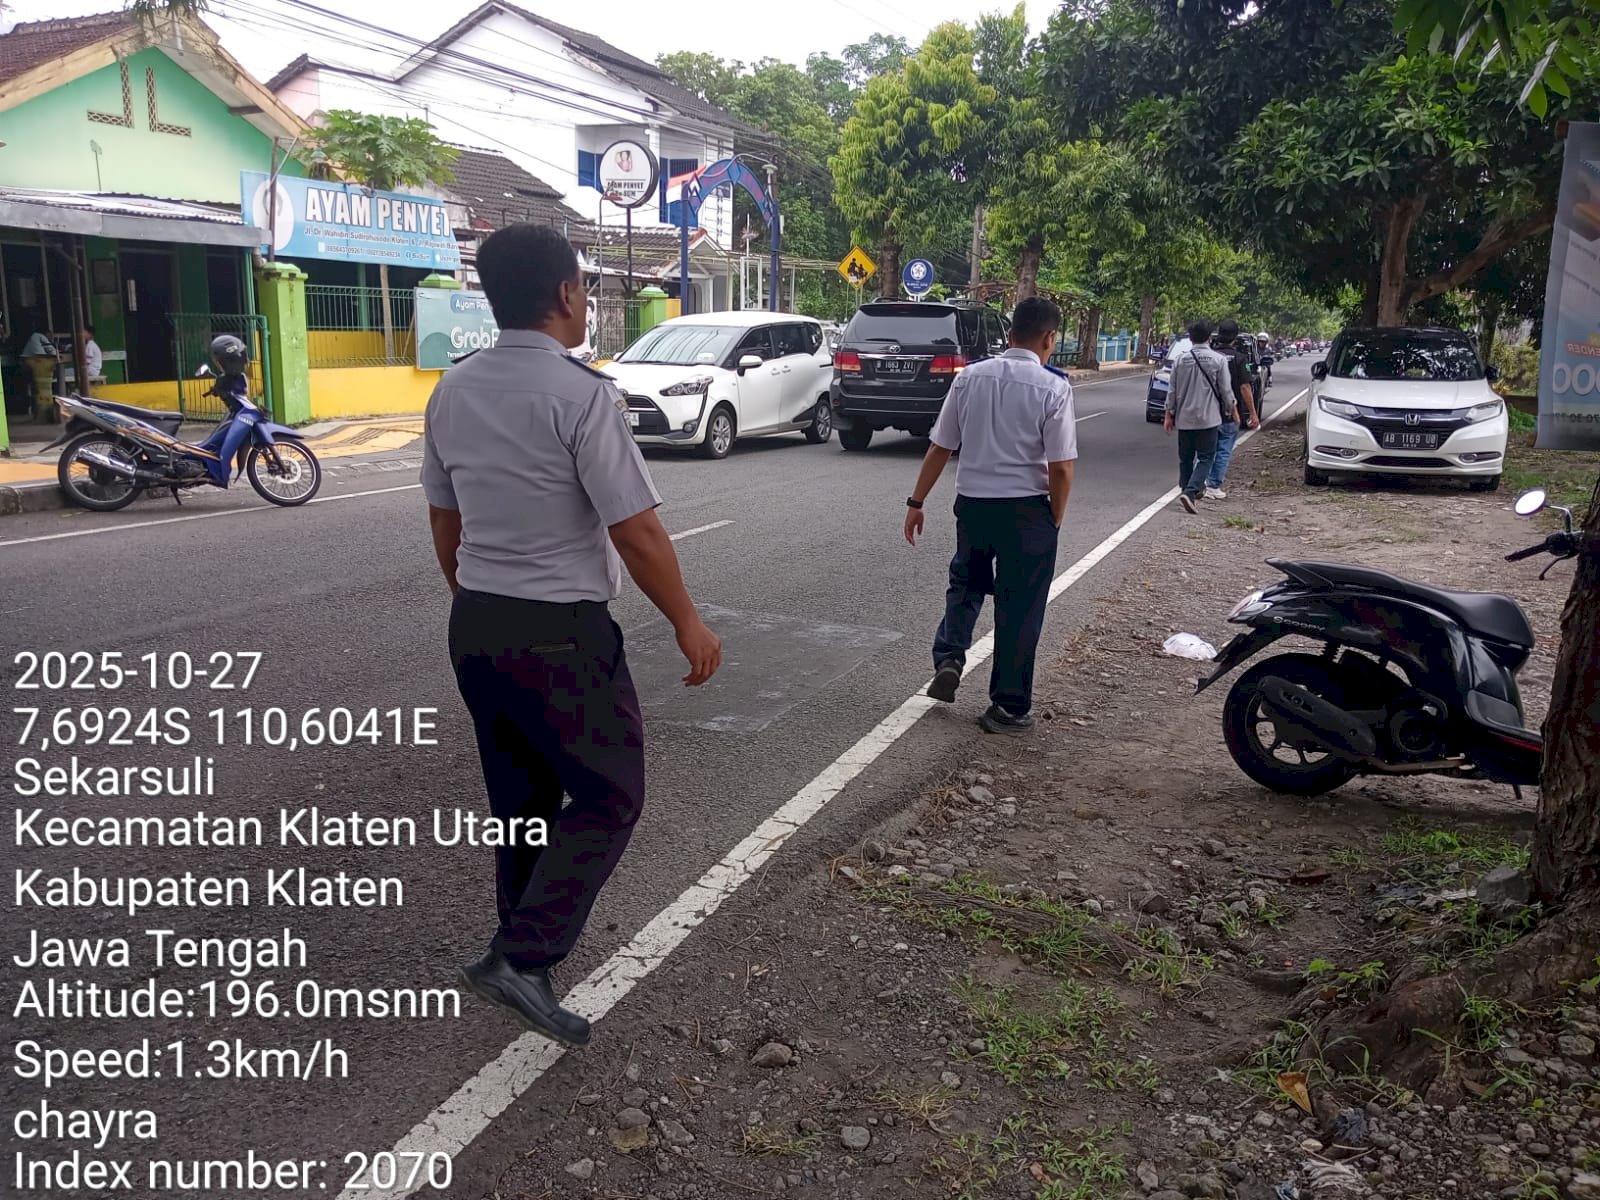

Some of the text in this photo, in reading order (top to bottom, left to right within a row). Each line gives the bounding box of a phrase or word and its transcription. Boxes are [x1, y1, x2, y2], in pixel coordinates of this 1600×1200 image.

[305, 187, 451, 237] AYAM PENYET
[455, 299, 476, 311] Ayam
[450, 326, 500, 349] GrabF
[1385, 433, 1395, 443] AB
[1402, 433, 1421, 444] 1169
